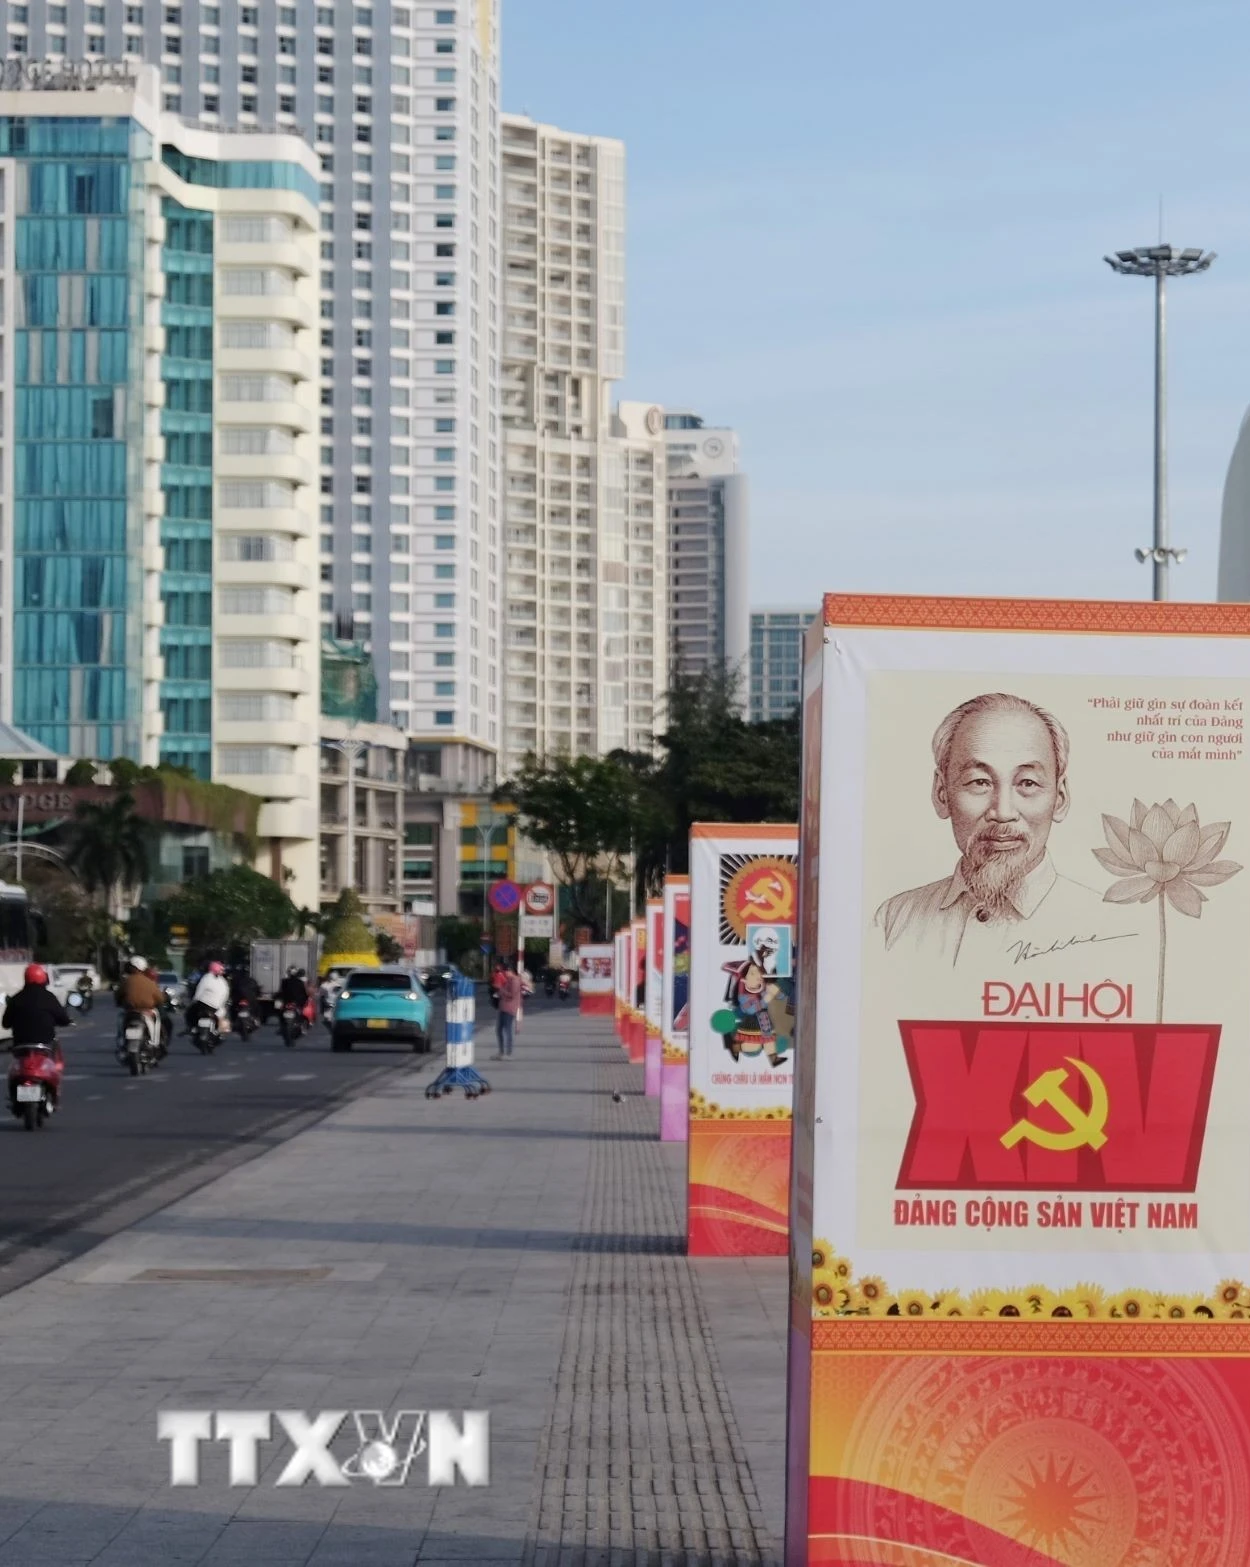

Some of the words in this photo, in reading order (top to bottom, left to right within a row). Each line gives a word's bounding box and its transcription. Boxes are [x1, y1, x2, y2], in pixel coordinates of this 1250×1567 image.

[1124, 698, 1144, 711] giữ
[1171, 698, 1186, 712] sự
[1189, 698, 1220, 711] đoàn
[1224, 697, 1243, 711] kết
[1136, 712, 1164, 726] nhất
[1168, 714, 1181, 726] trí
[1185, 714, 1207, 727] của
[1211, 714, 1243, 729] Đảng
[1107, 730, 1131, 742] như
[1134, 731, 1154, 744] giữ
[1181, 733, 1203, 743] con
[1151, 746, 1174, 759] của
[1178, 746, 1201, 760] mắt
[981, 981, 1051, 1019] ĐẠI
[1058, 978, 1133, 1022] HỘI
[894, 1193, 957, 1226] ĐẢNG
[965, 1196, 1028, 1232] CỘNG
[1037, 1194, 1082, 1229] SẢN
[1090, 1197, 1140, 1234] VIỆT
[1147, 1202, 1198, 1229] NAM
